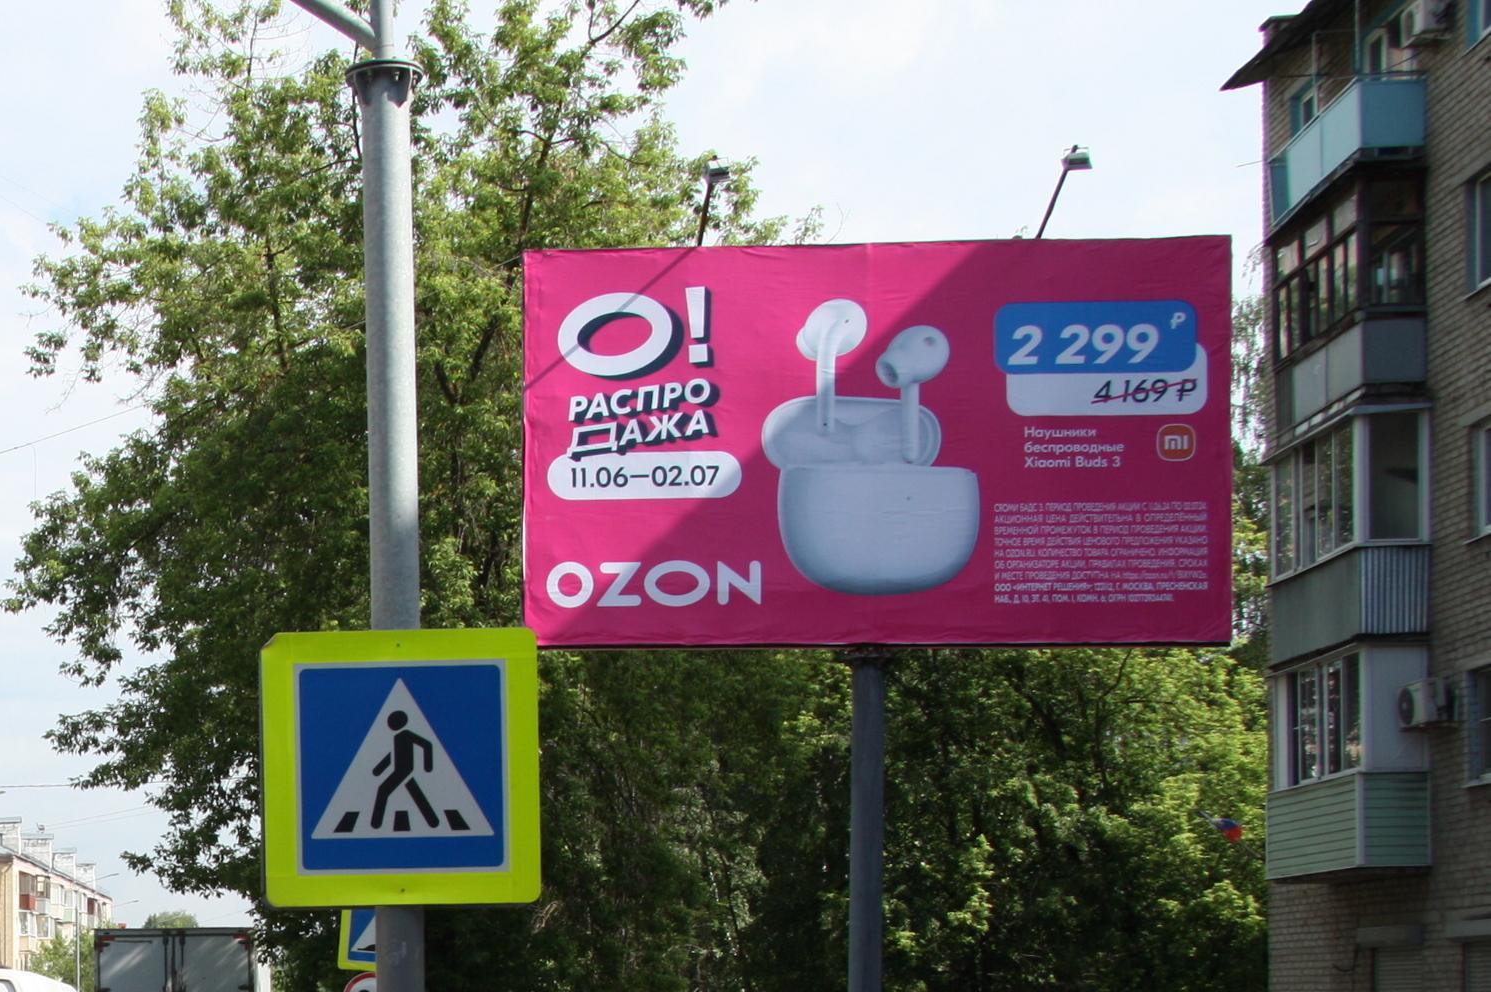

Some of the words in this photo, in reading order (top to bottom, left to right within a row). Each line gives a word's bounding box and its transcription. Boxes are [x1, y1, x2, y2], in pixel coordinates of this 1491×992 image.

[558, 286, 712, 377] О!
[1007, 325, 1044, 366] 2
[1055, 323, 1159, 365] 299
[568, 378, 713, 421] РАСПРО
[1121, 378, 1169, 403] 169
[566, 410, 711, 458] ДАЖА
[1024, 426, 1097, 440] Наушники
[1024, 441, 1125, 456] беспроводные
[1024, 455, 1071, 468] Xiaomi
[1075, 455, 1108, 467] Buds
[1112, 455, 1122, 467] 3
[546, 560, 762, 608] OZON
